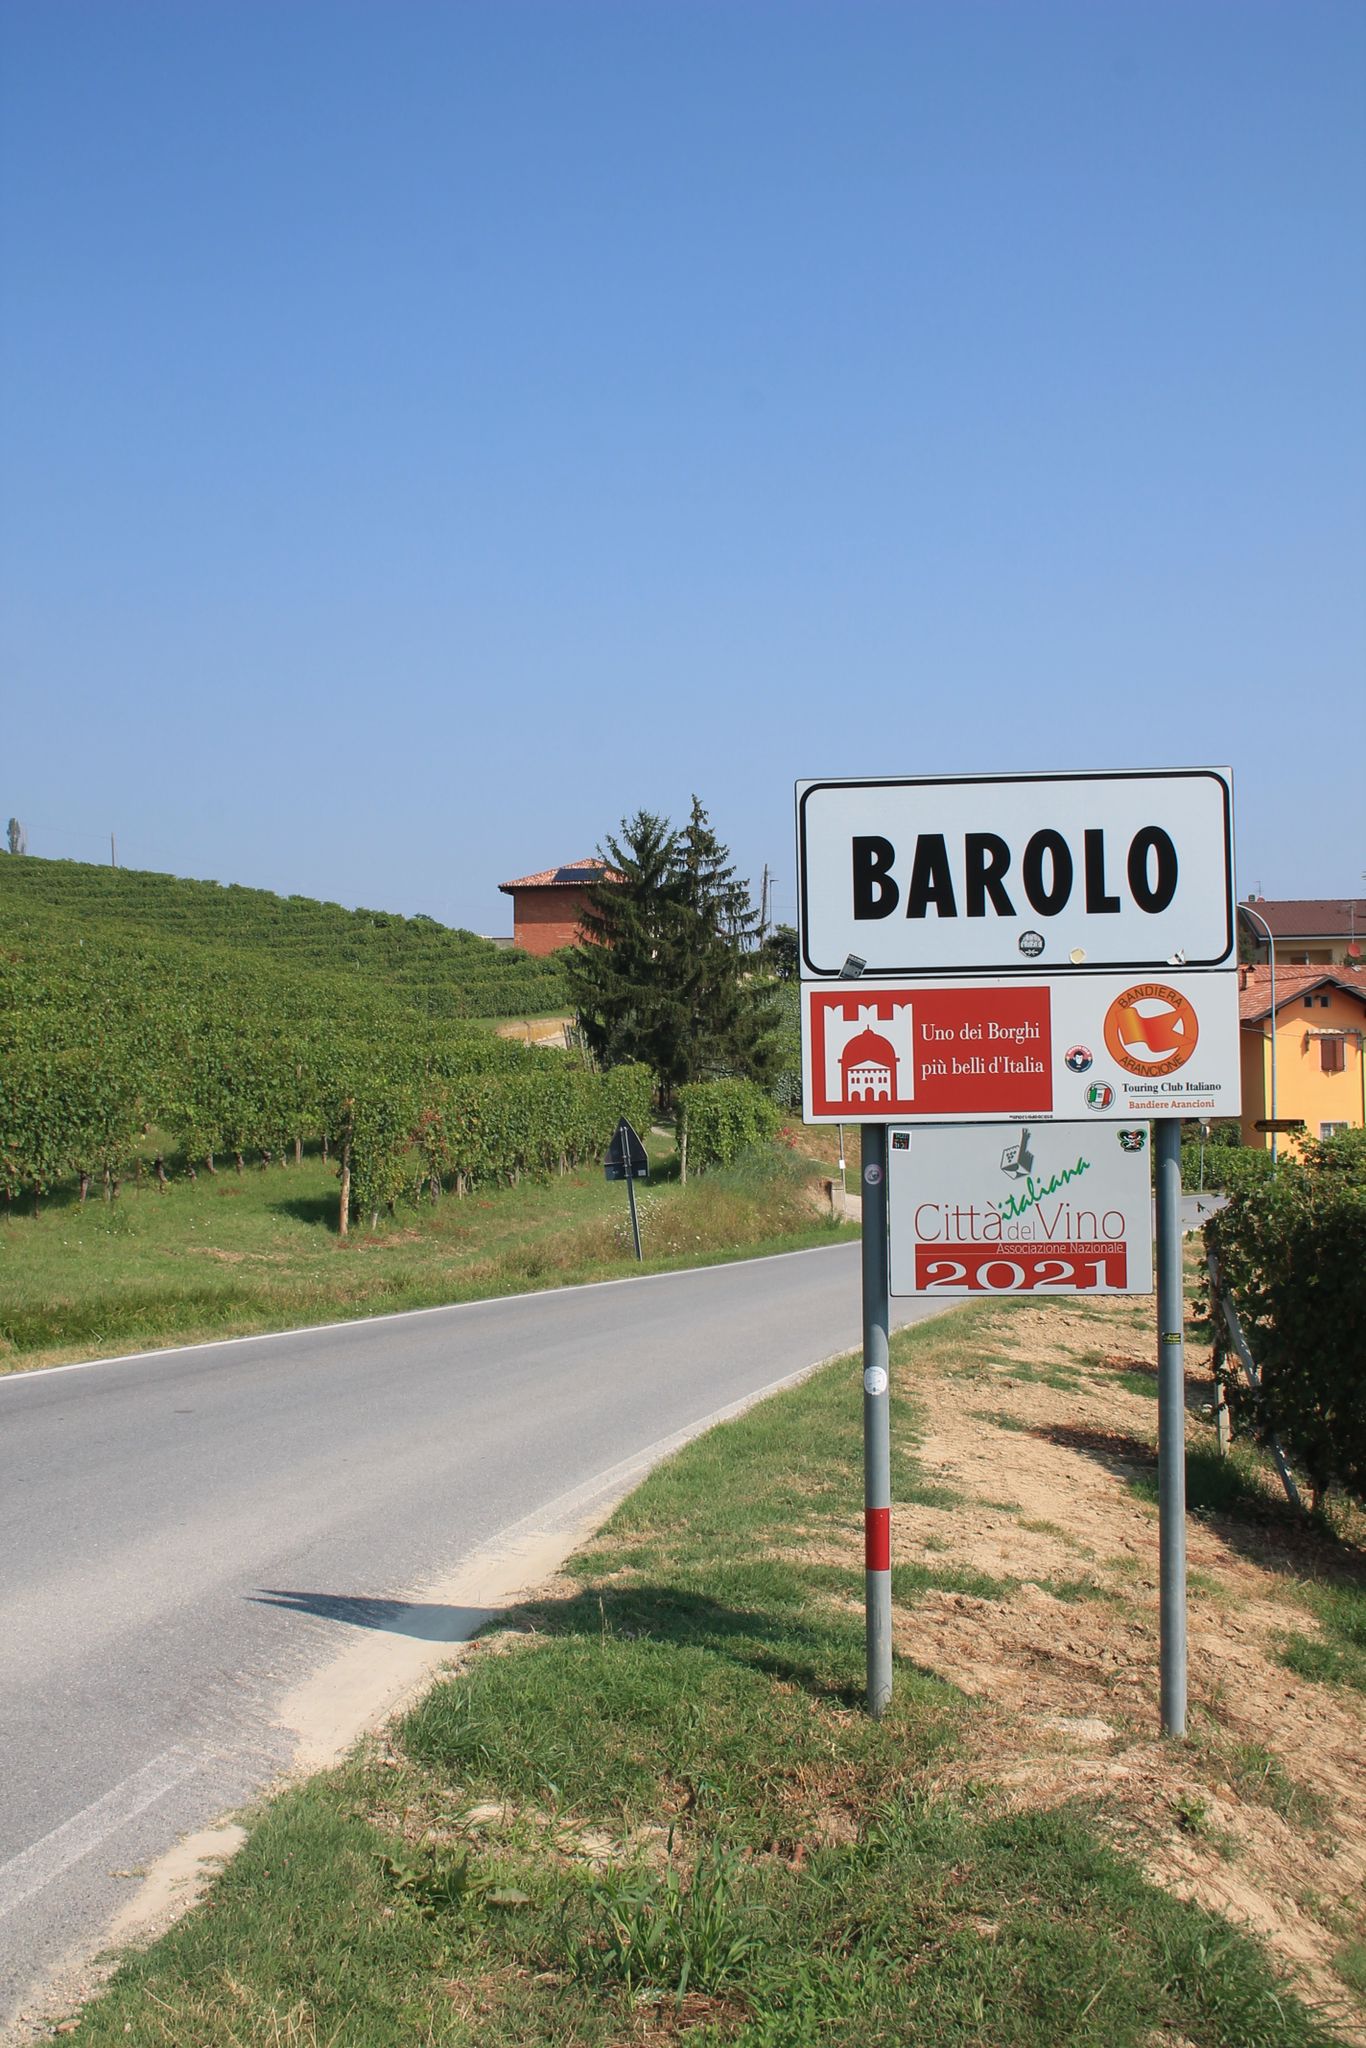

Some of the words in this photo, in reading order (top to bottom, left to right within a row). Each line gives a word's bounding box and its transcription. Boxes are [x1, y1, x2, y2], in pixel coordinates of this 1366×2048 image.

[852, 826, 1178, 920] BAROLO
[1118, 986, 1183, 1009] BANDIERA
[921, 1023, 955, 1041] Uno
[959, 1023, 983, 1040] dei
[987, 1022, 1040, 1044] Borghi
[921, 1059, 947, 1080] più
[951, 1057, 986, 1075] belli
[988, 1056, 1044, 1073] d'Italia
[1120, 1054, 1185, 1077] ARANCIONE
[1122, 1083, 1159, 1094] Touring
[1161, 1082, 1183, 1092] Club
[1186, 1082, 1222, 1091] Italiano
[1129, 1101, 1169, 1109] Bandiere
[1171, 1099, 1215, 1108] Arancioni
[998, 1157, 1090, 1220] italiana
[914, 1201, 1002, 1241] Città
[1007, 1221, 1036, 1241] del
[1036, 1202, 1125, 1240] Vino
[996, 1243, 1066, 1254] Associazione
[1070, 1242, 1123, 1254] Nazionale
[926, 1260, 1118, 1290] 2021
